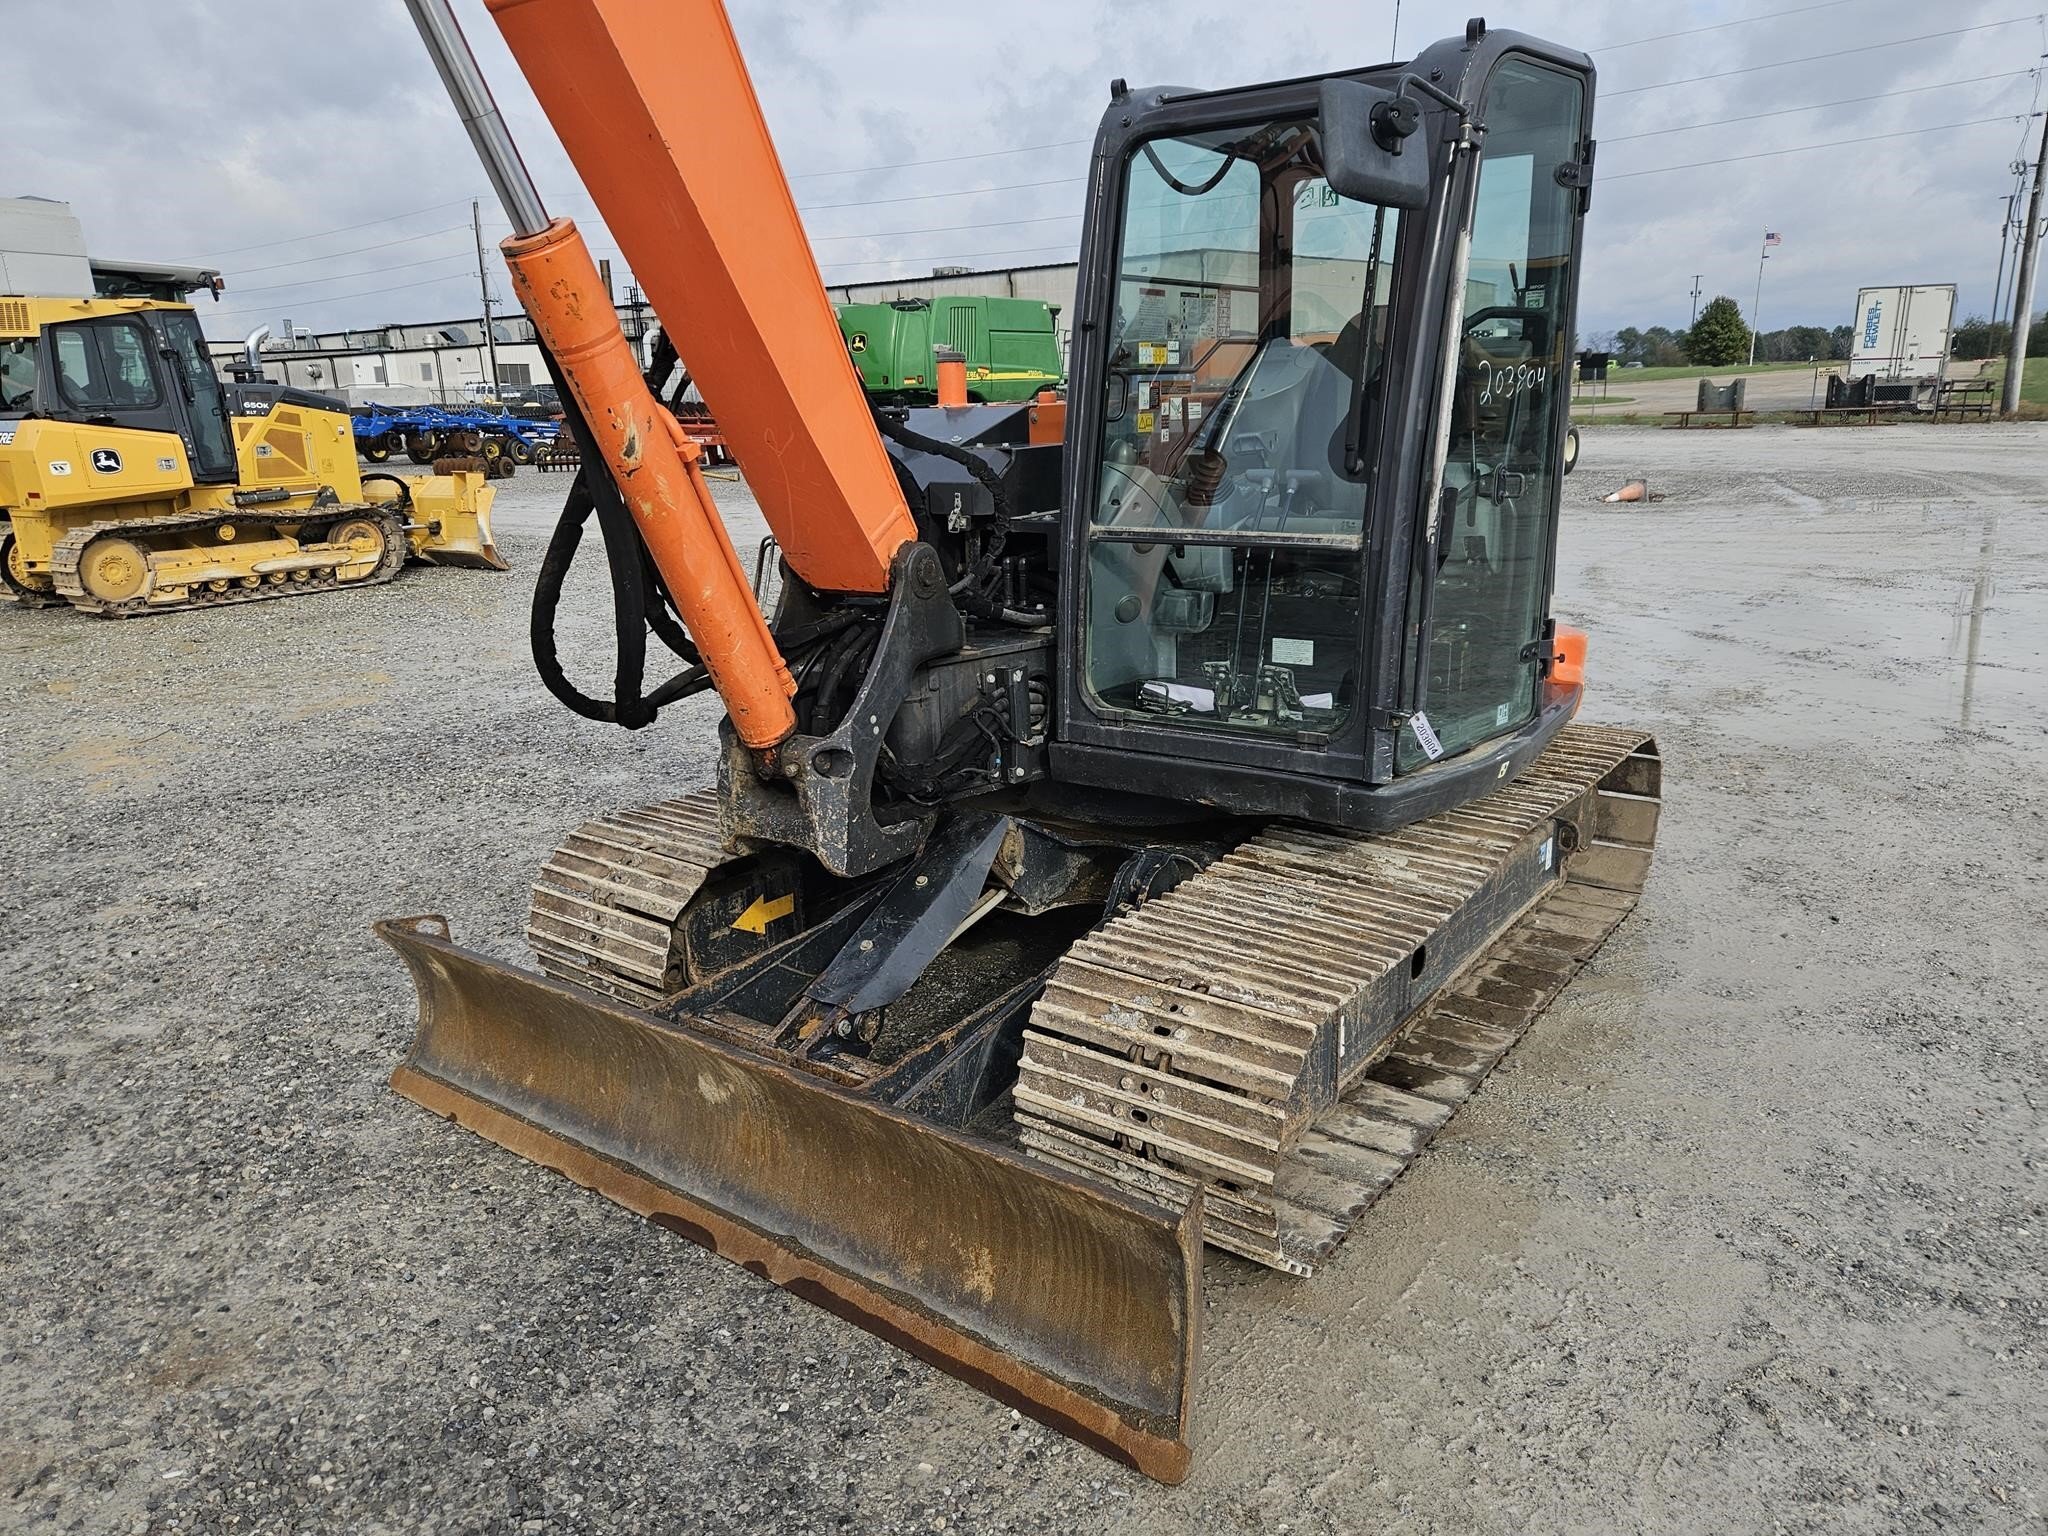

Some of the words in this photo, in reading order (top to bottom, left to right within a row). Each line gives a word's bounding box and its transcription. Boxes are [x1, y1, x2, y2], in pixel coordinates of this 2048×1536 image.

[1863, 307, 1875, 349] FORBES
[1869, 300, 1882, 349] HEWLETT
[1478, 360, 1546, 405] 203804
[243, 401, 269, 409] 650K
[1416, 723, 1439, 755] 203804
